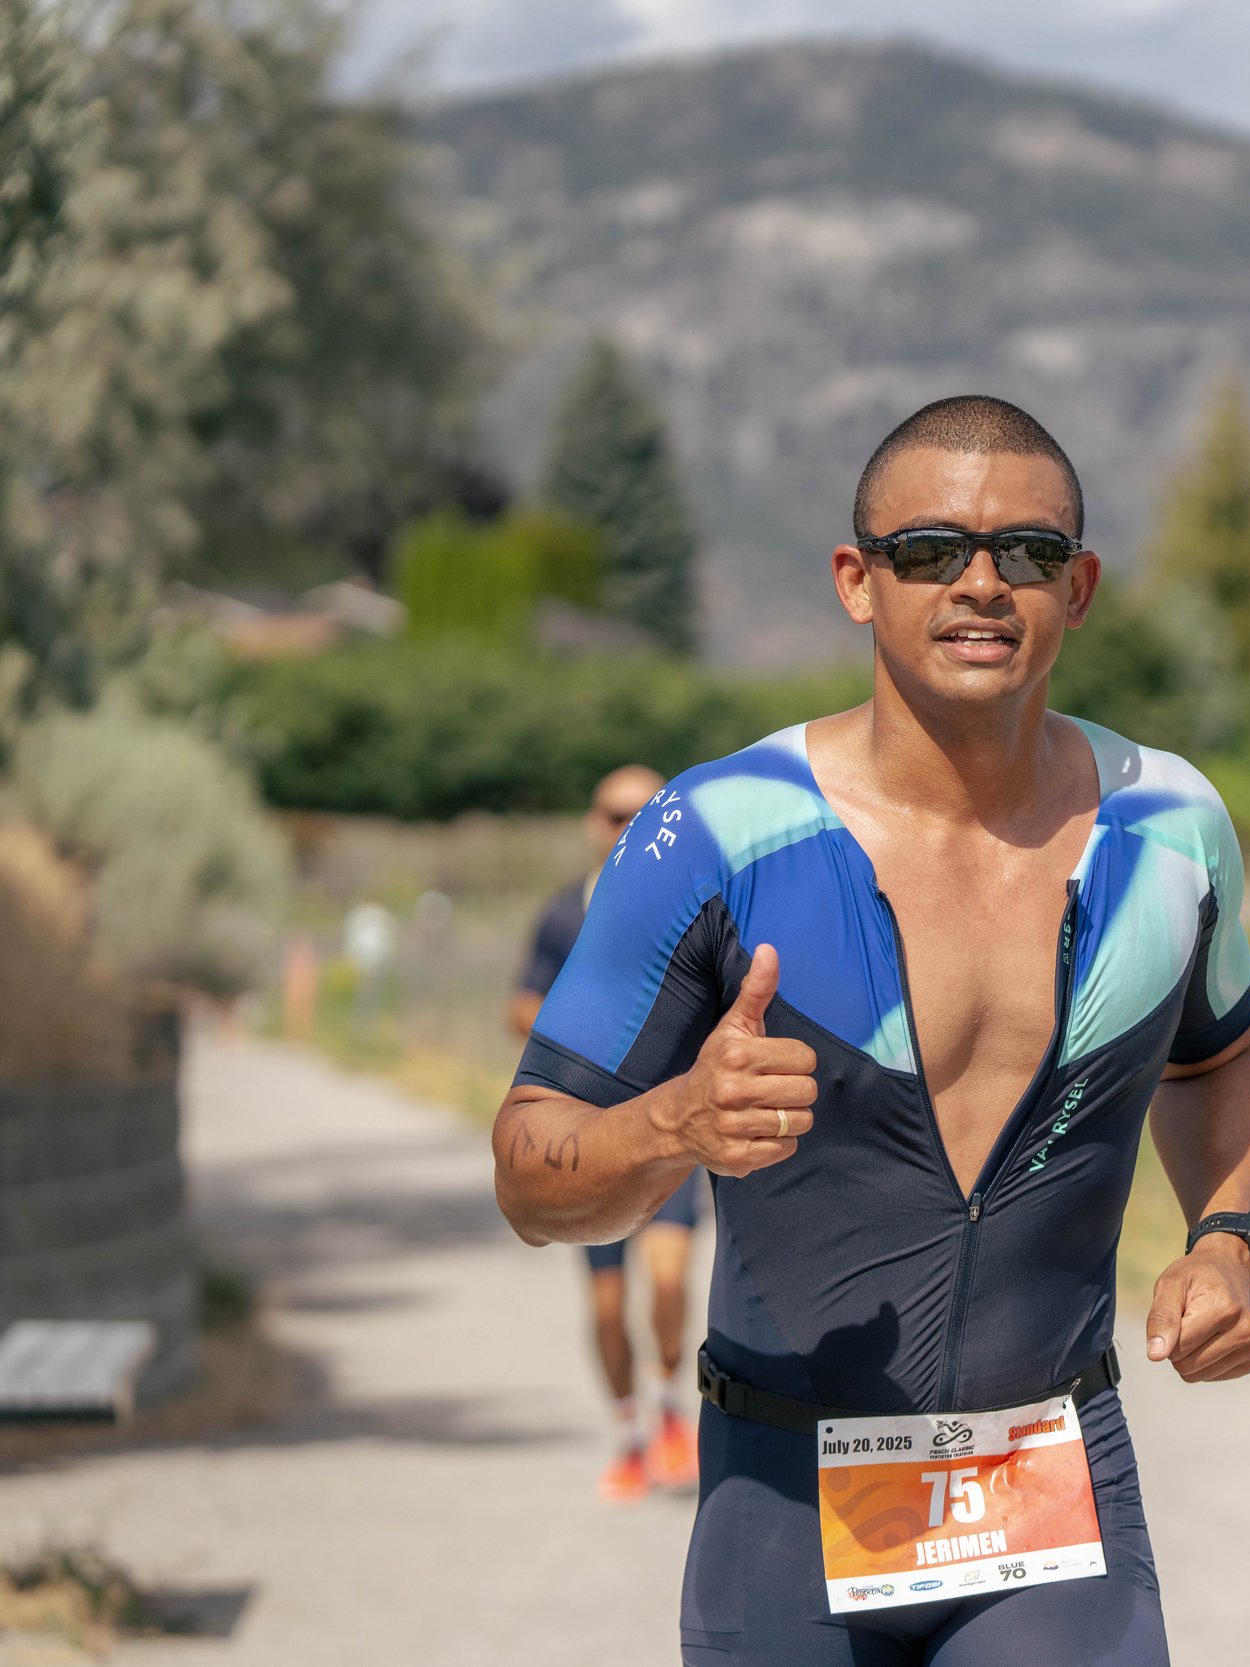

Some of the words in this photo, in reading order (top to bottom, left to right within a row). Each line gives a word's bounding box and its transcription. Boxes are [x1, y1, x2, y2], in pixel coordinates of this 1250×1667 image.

[644, 789, 682, 861] RYSEL
[1028, 1139, 1054, 1173] VA
[1051, 1078, 1089, 1135] RYSEL
[1008, 1414, 1066, 1441] Standard
[822, 1439, 849, 1455] July
[852, 1437, 874, 1453] 20,
[876, 1435, 912, 1451] 2025
[921, 1466, 986, 1528] 75
[915, 1529, 1008, 1566] JERIMEN
[998, 1561, 1025, 1571] BLUE
[999, 1568, 1027, 1582] 70
